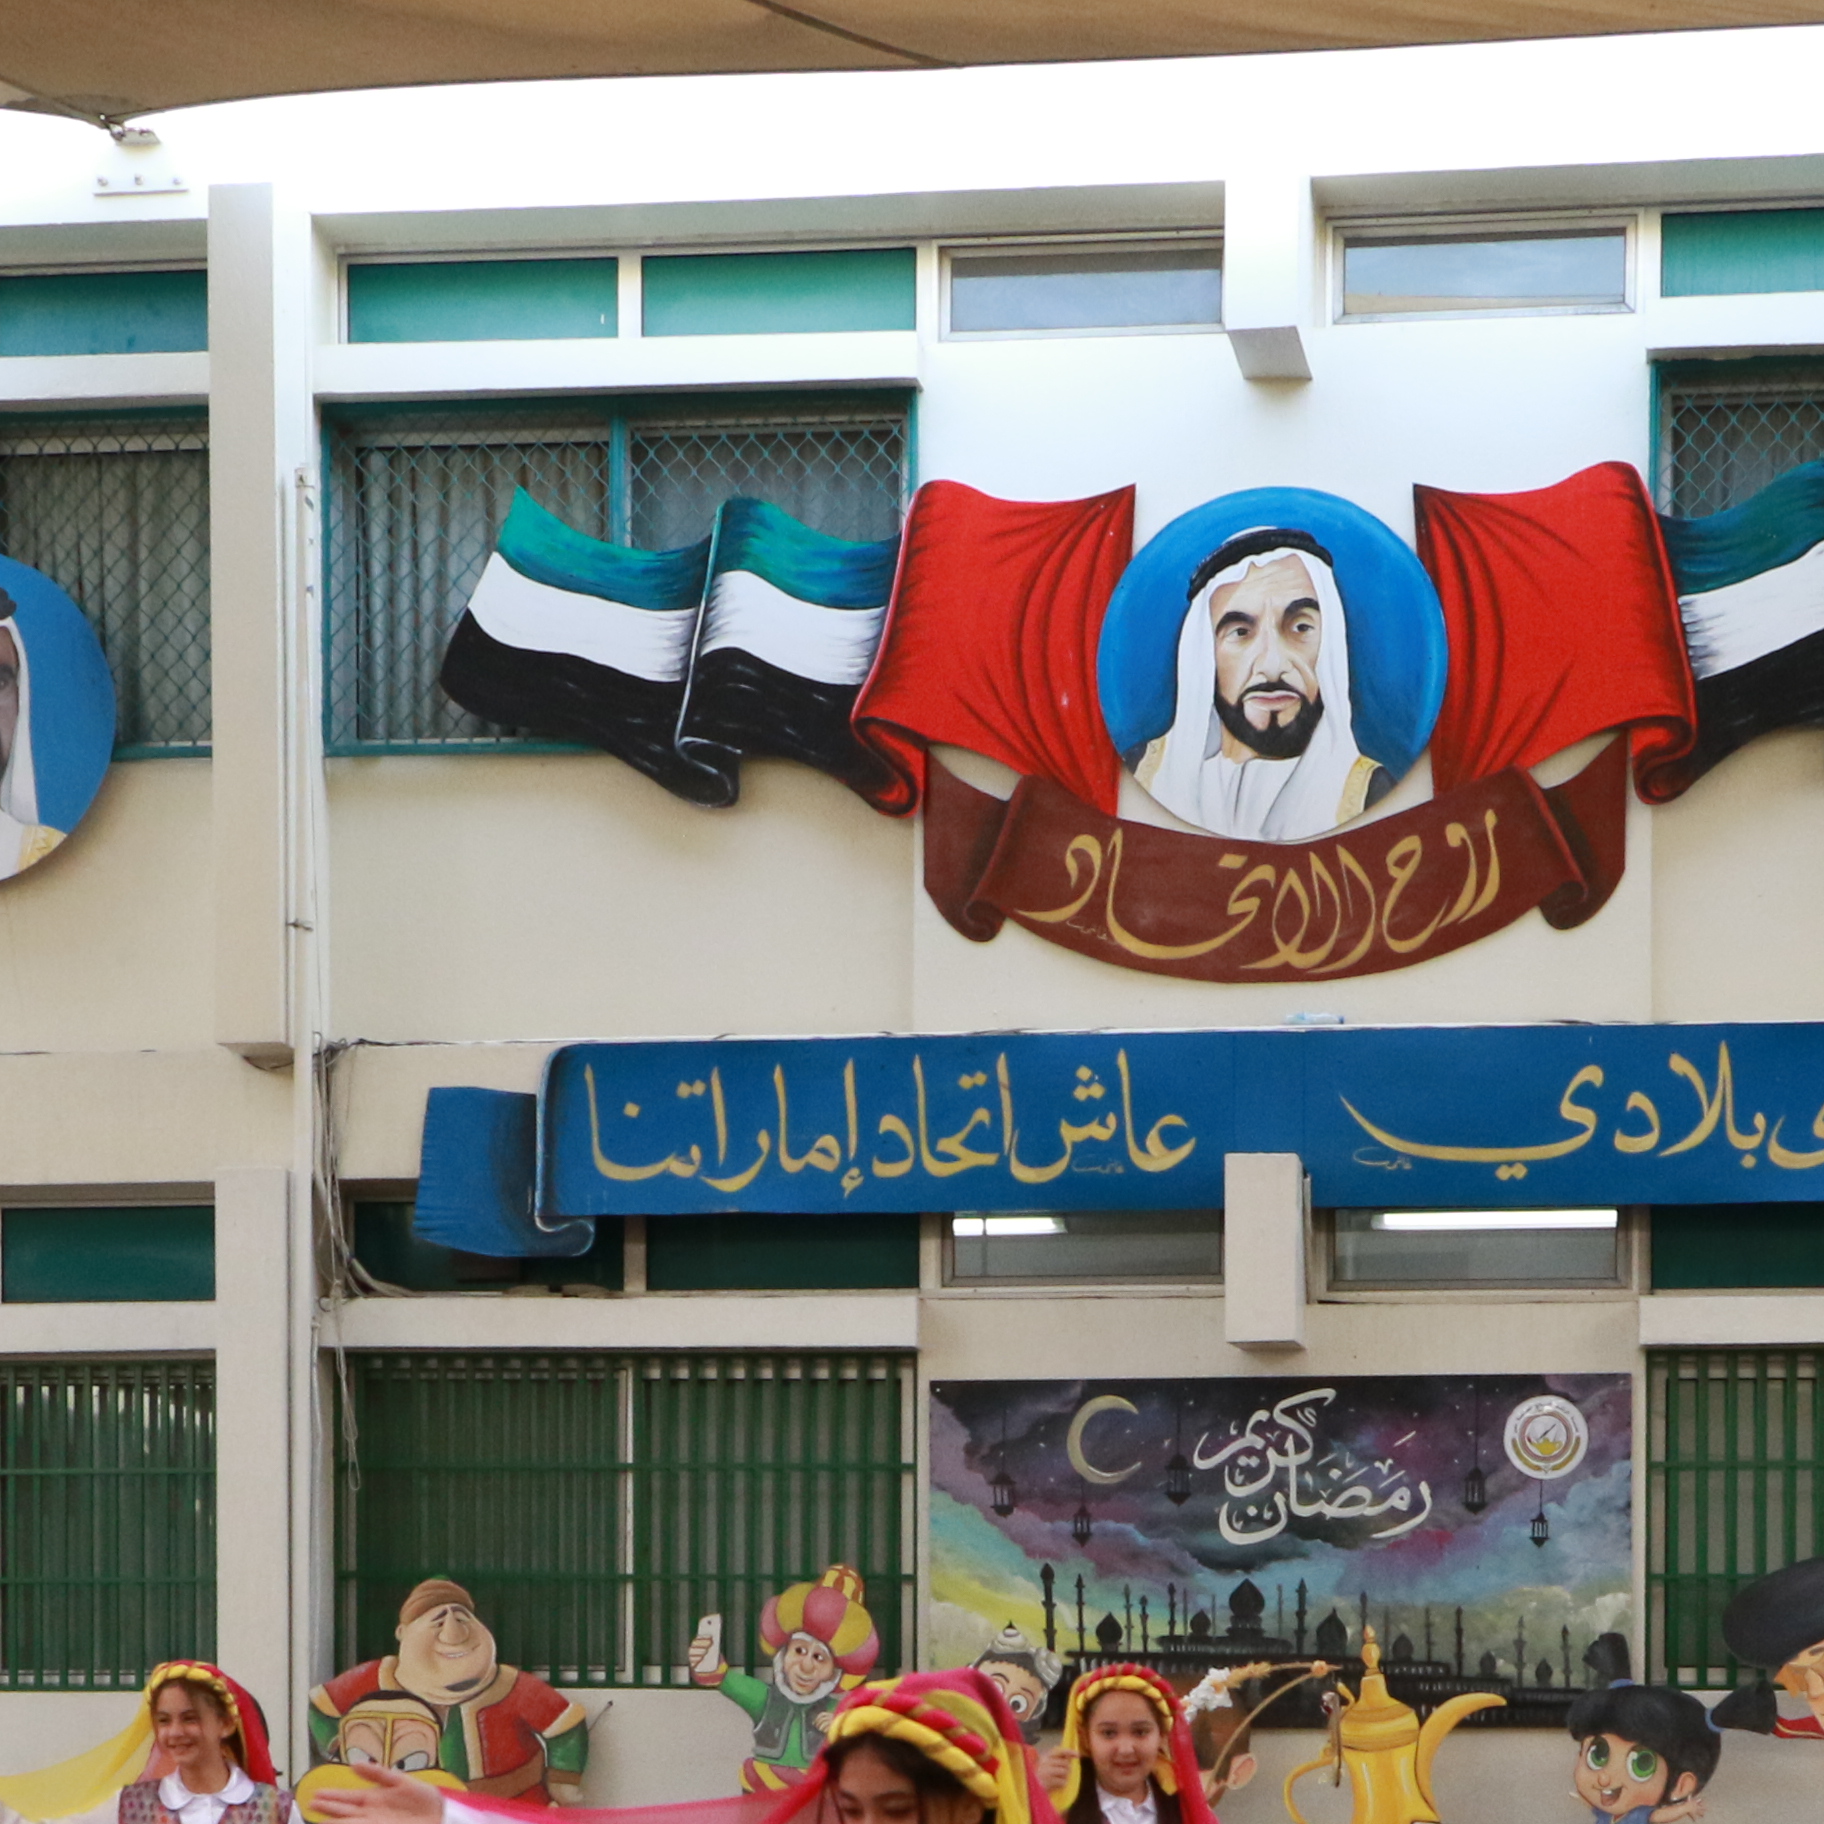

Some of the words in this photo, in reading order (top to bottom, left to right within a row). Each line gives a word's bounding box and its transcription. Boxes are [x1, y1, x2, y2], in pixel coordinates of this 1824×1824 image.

[1018, 828, 1376, 974] الاتحاد
[1381, 809, 1501, 955] روح
[583, 1056, 865, 1199] إماراتنا
[871, 1051, 1014, 1178] اتحاد
[1008, 1048, 1197, 1185] عاش
[1338, 1040, 1768, 1181] بلادي
[1193, 1388, 1337, 1498] كريم
